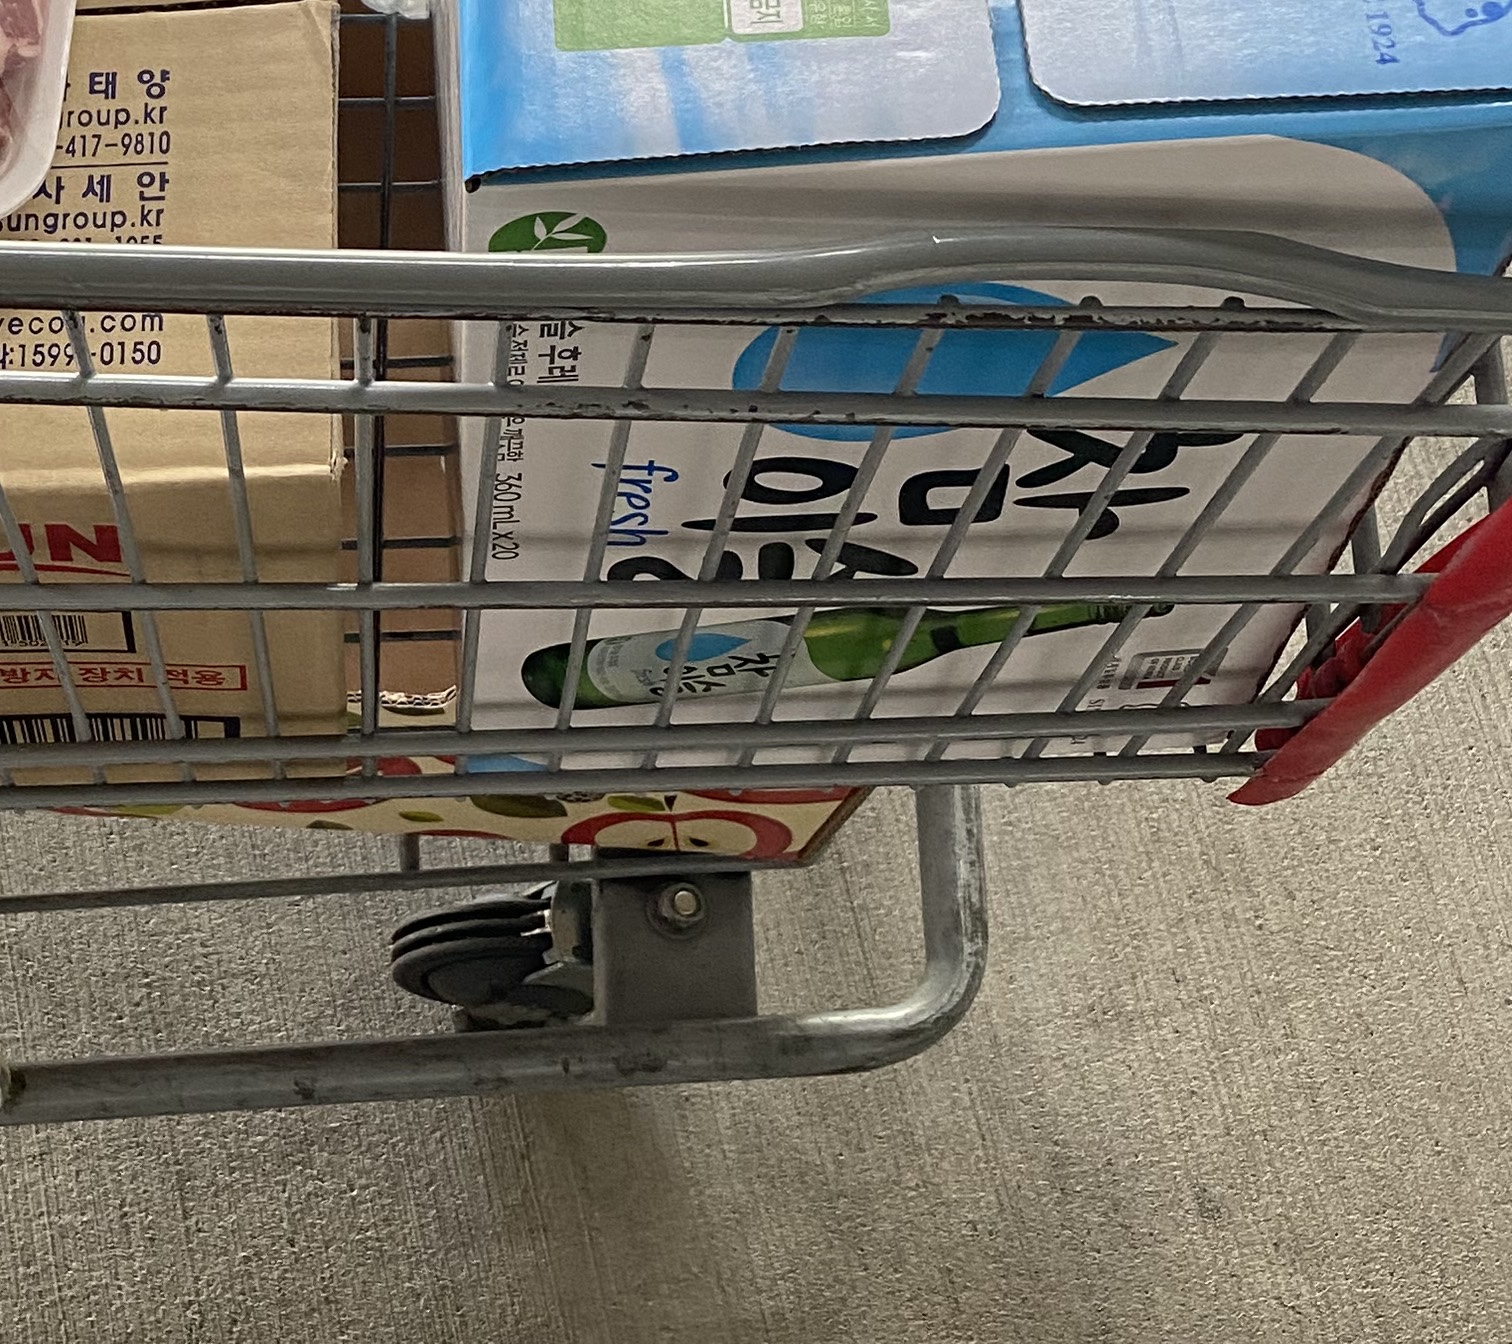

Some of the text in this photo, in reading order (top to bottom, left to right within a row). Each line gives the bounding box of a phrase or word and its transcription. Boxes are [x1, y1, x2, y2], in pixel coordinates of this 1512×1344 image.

[1365, 10, 1400, 66] 1924
[493, 472, 522, 501] 360
[590, 458, 678, 548] fresh
[78, 667, 144, 684] 장치
